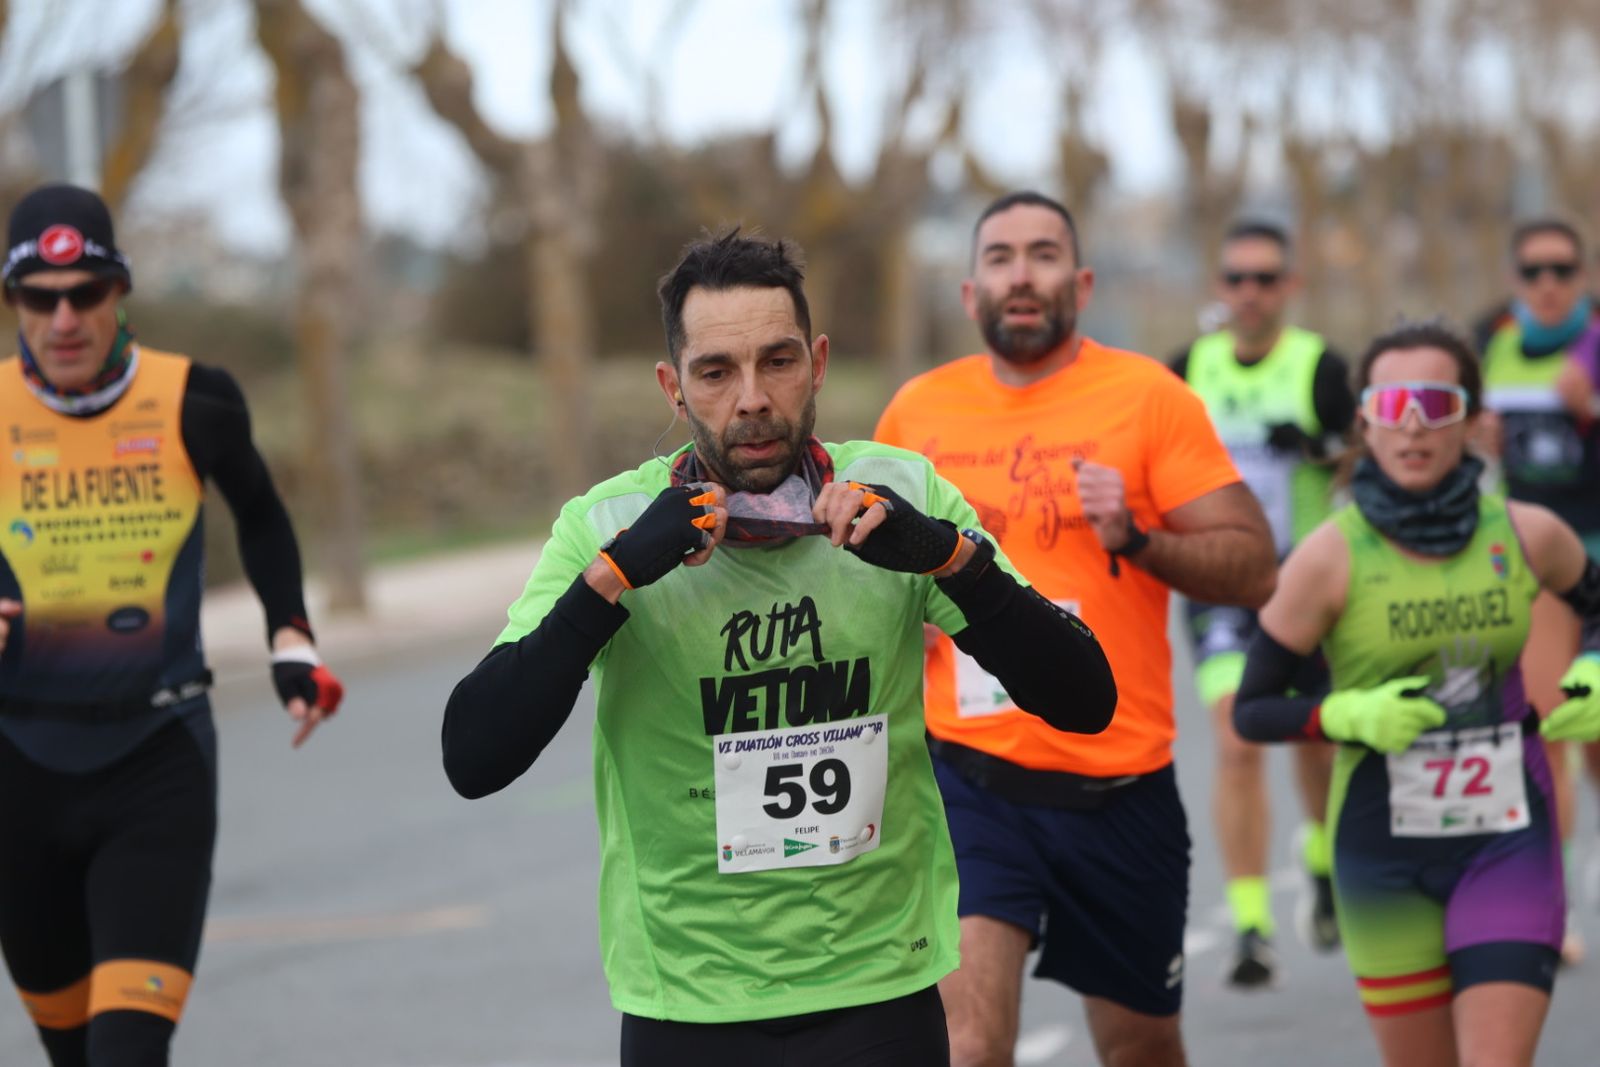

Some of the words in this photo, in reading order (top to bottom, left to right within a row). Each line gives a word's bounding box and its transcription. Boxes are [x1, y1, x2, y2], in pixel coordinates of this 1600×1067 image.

[21, 471, 48, 512] DE
[53, 469, 81, 510] LA
[84, 463, 165, 507] FUENTE
[720, 595, 825, 672] RUTA
[1388, 588, 1512, 641] RODRÍGUEZ
[700, 656, 870, 736] VETONA
[718, 741, 732, 754] VI
[735, 734, 782, 753] DUATLÓN
[786, 731, 820, 747] CROSS
[762, 758, 851, 819] 59
[1424, 755, 1493, 799] 72
[795, 826, 820, 835] FELIPE
